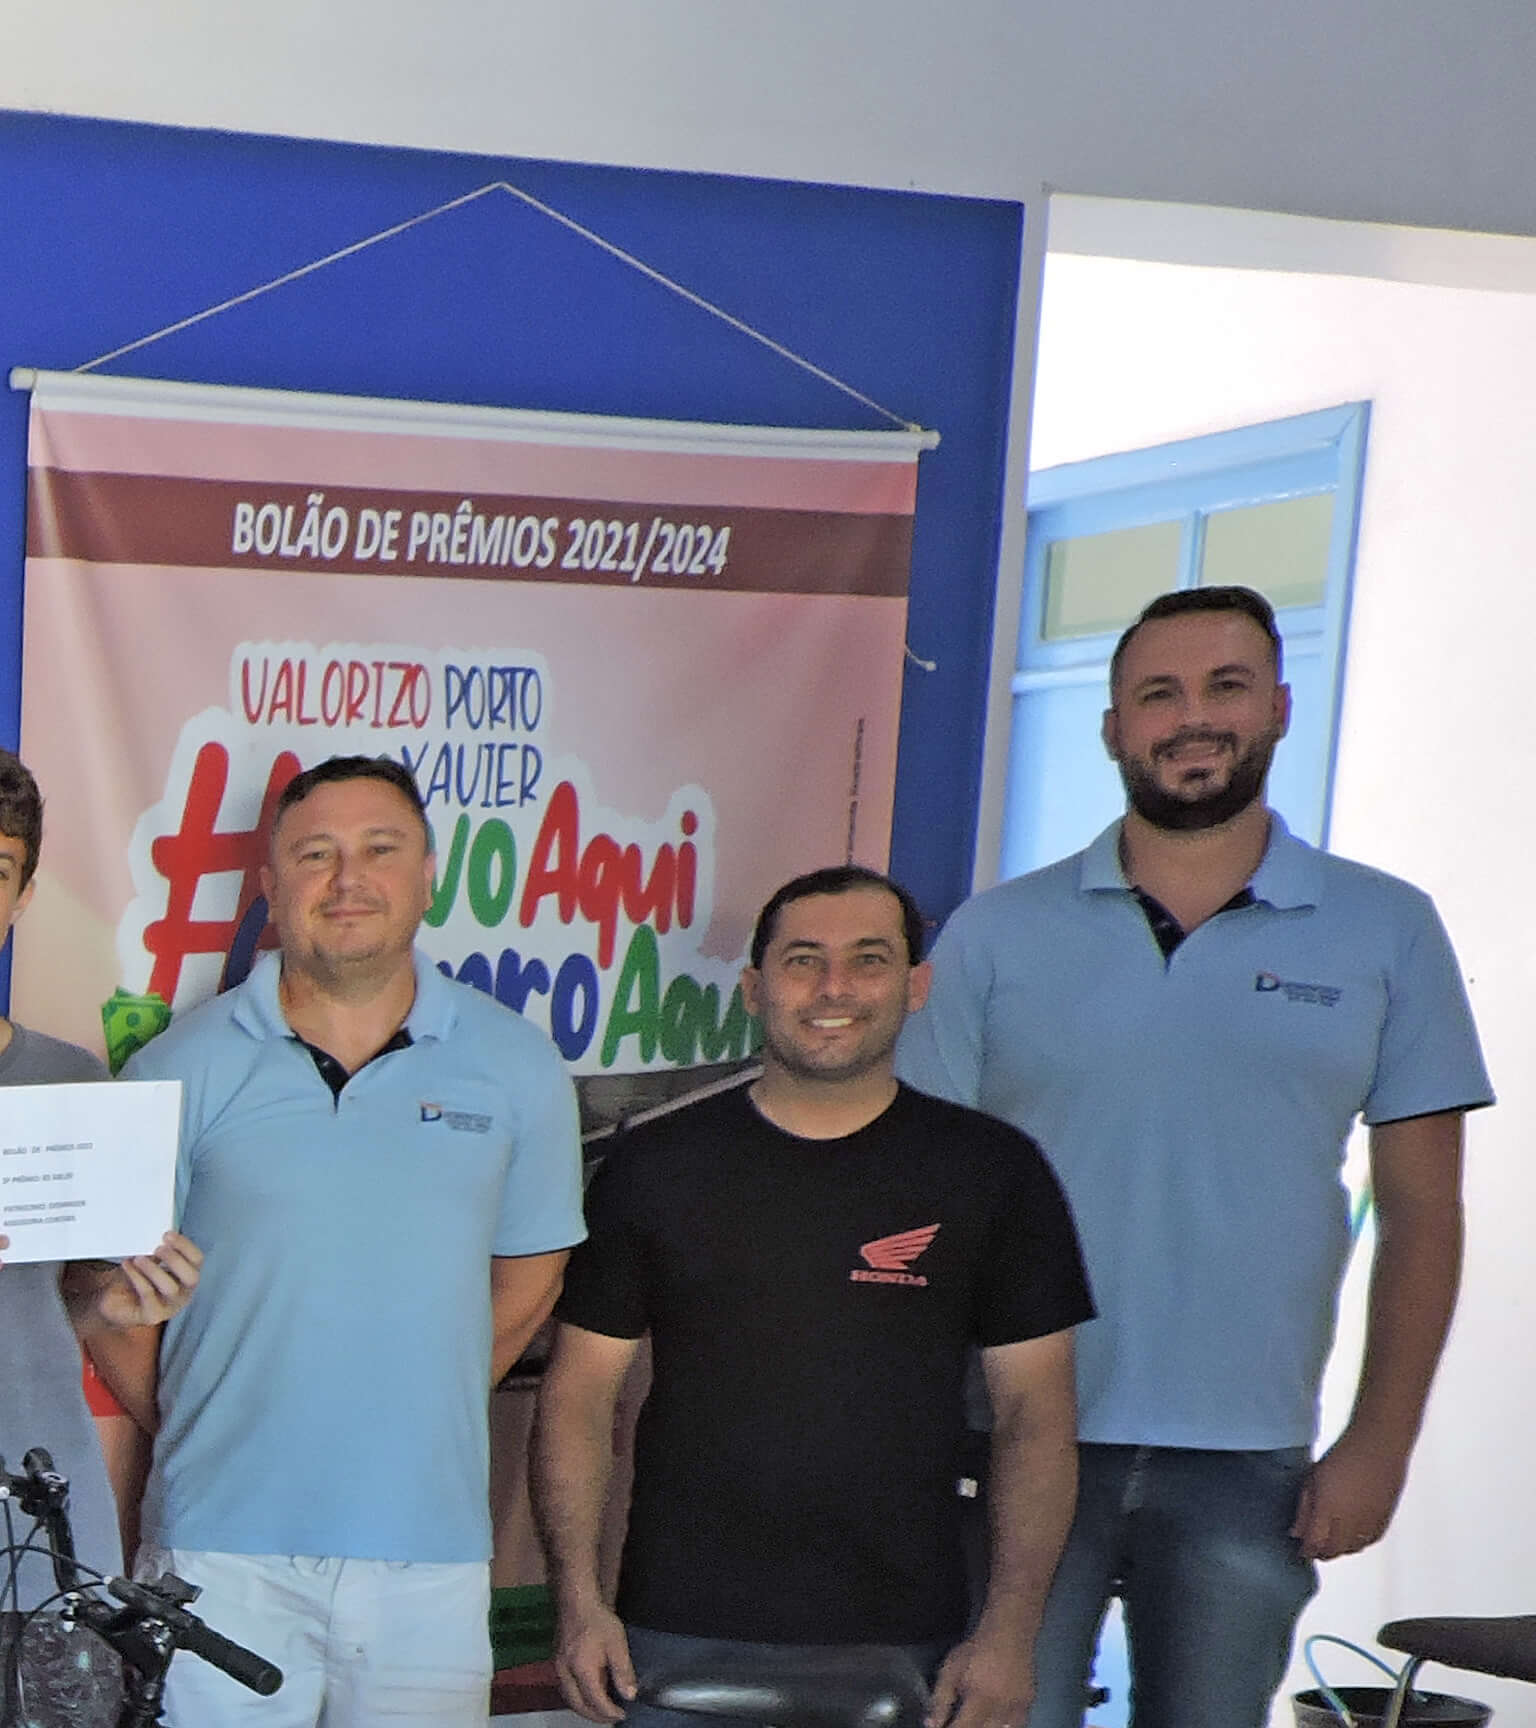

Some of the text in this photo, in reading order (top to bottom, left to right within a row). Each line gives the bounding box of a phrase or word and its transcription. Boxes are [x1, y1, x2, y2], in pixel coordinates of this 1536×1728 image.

[233, 493, 731, 583] BOLÃO DE PRÊMIOS 2021/2024
[241, 658, 543, 732] VALORIZO PORTO
[401, 741, 544, 808] XAVIER
[849, 1269, 929, 1287] HONDA
